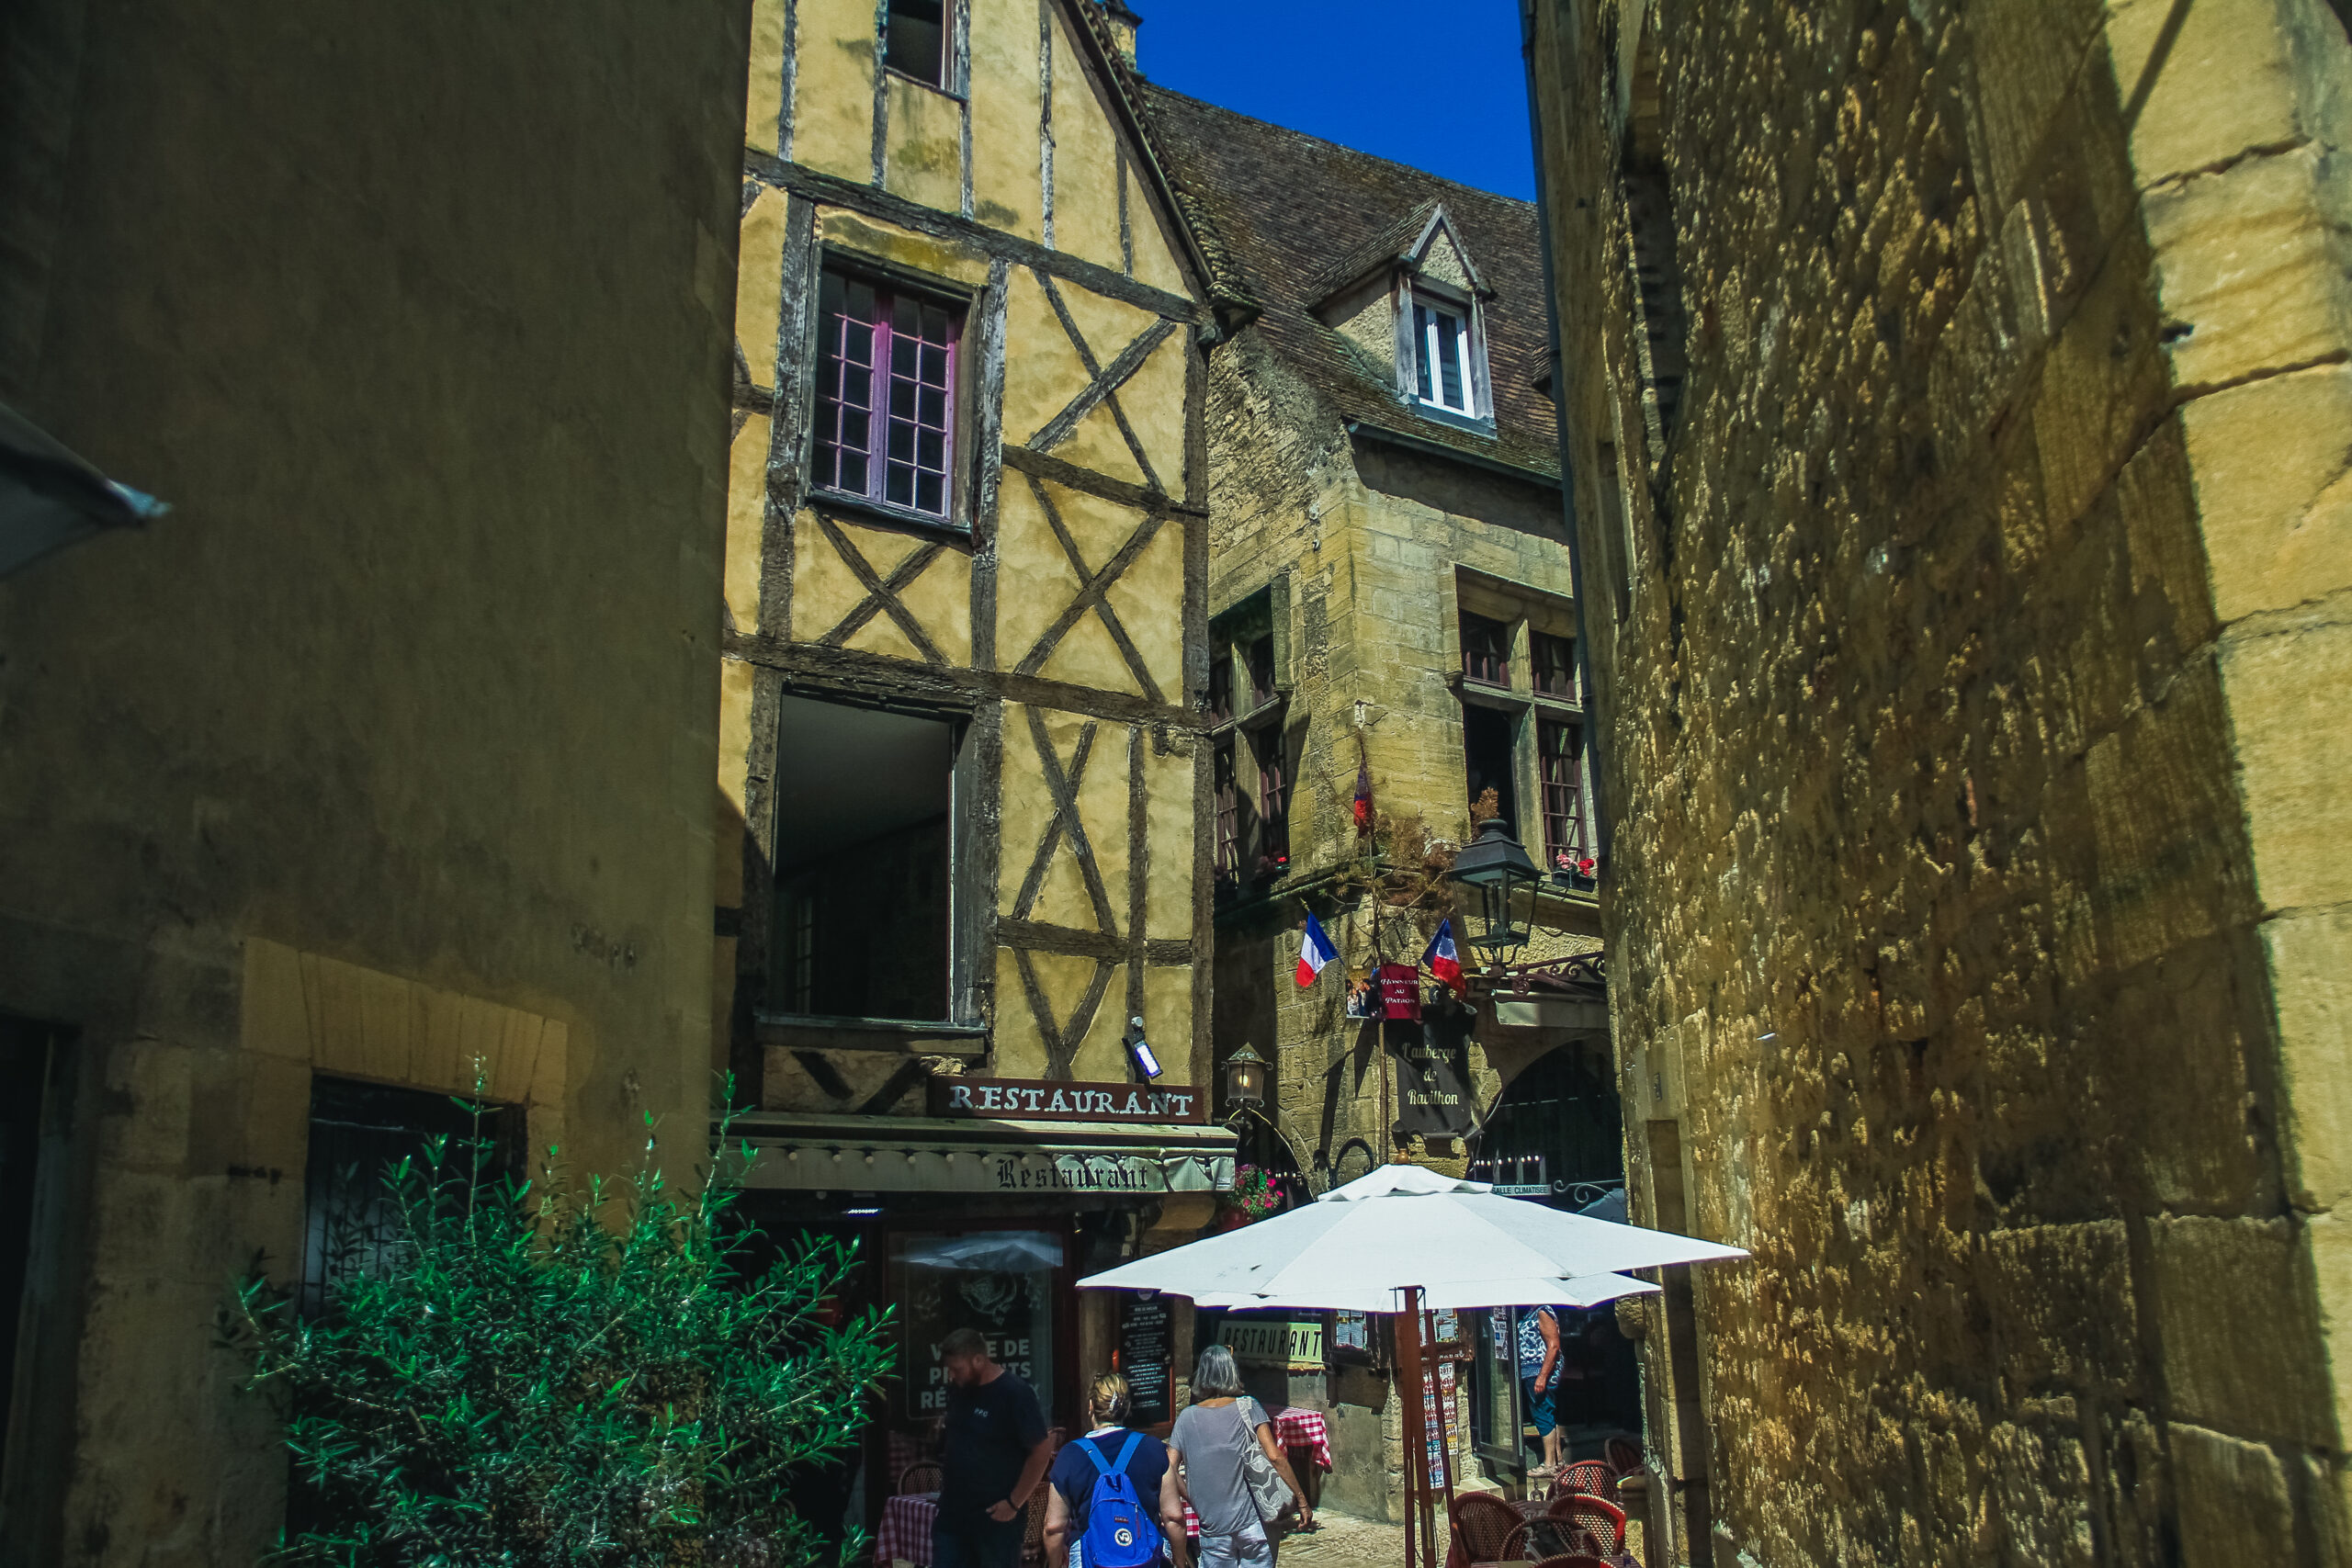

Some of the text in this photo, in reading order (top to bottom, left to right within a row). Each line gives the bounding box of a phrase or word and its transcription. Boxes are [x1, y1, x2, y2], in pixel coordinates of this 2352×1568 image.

[1385, 997, 1416, 1005] PATRON
[1402, 1043, 1456, 1064] L'auberge
[1423, 1067, 1437, 1082] de
[949, 1085, 1193, 1118] RESTAURANT
[1407, 1089, 1459, 1105] Ravilhon
[996, 1157, 1148, 1190] Restaurant
[1491, 1186, 1511, 1195] SALLE
[1003, 1338, 1030, 1358] DE
[1224, 1327, 1322, 1357] RESTAURANT
[1440, 1366, 1453, 1374] 2017
